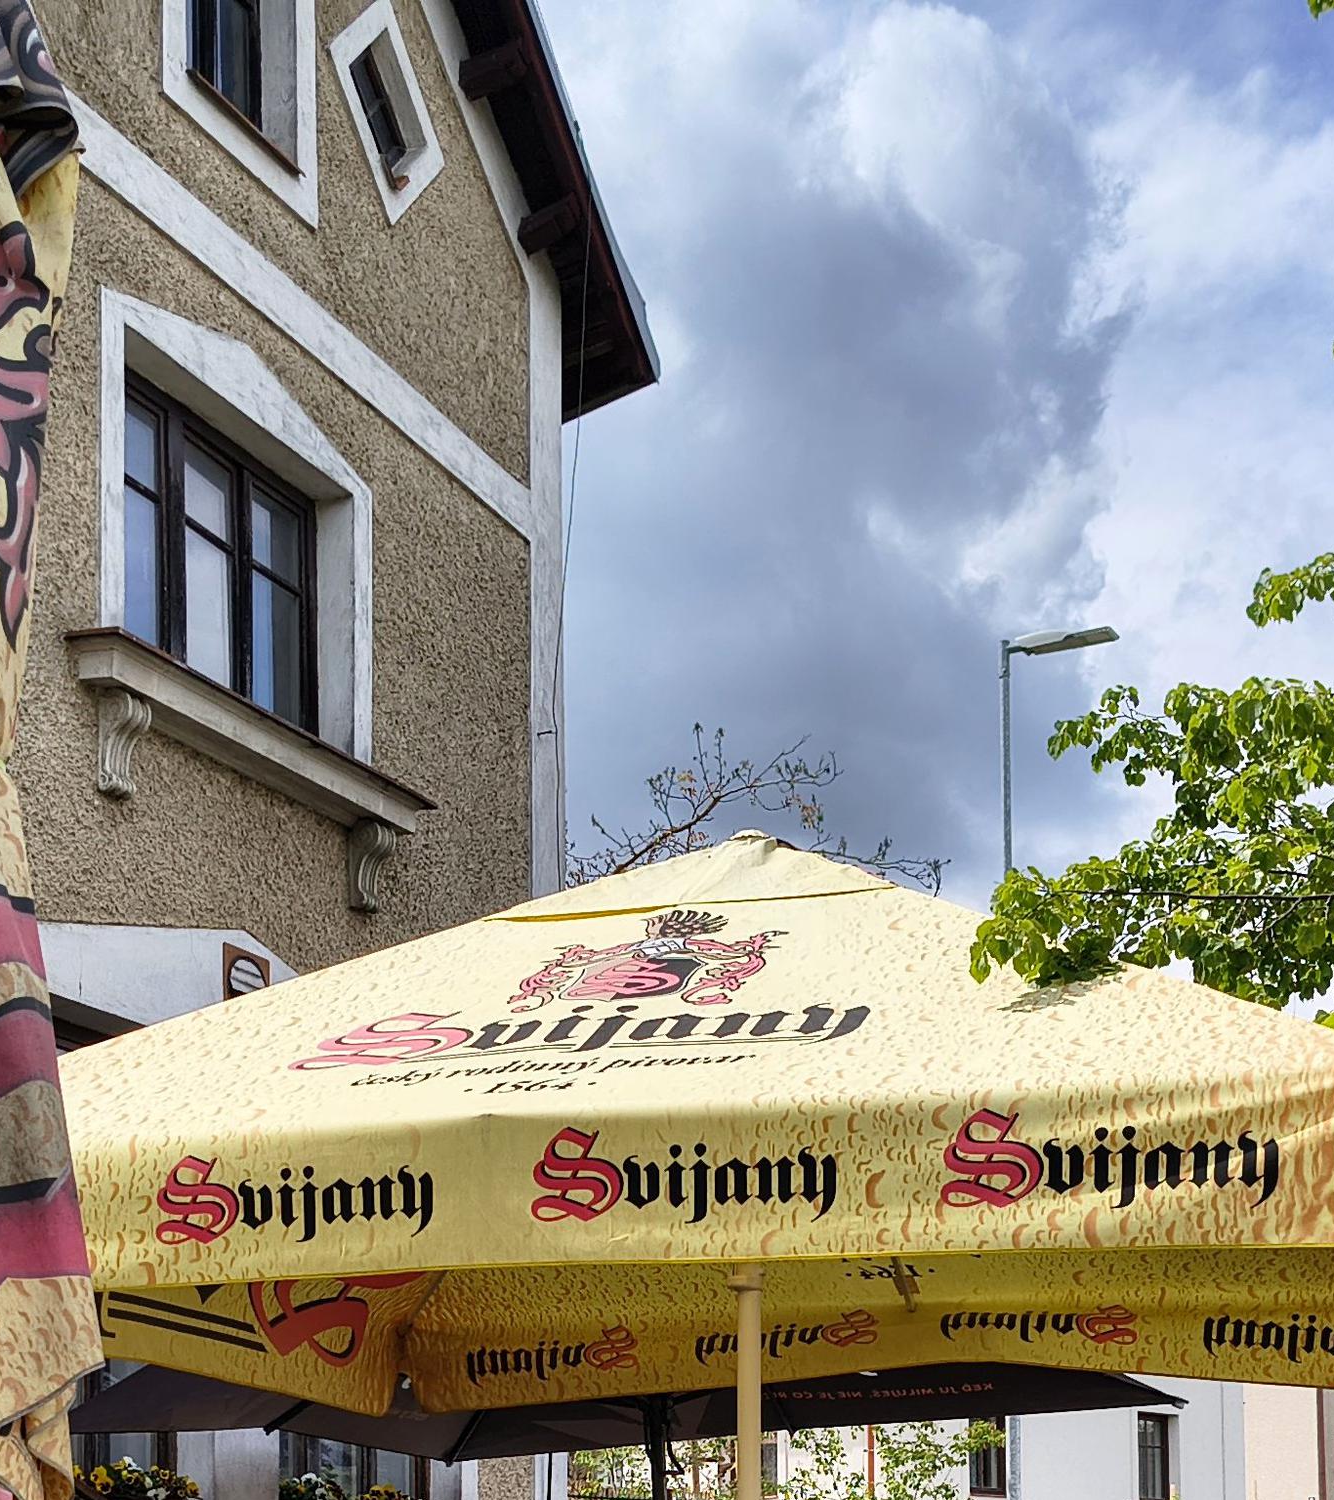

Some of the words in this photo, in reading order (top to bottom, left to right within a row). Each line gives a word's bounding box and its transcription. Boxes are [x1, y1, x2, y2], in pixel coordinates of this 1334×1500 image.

[288, 1004, 871, 1072] Svijany
[351, 1064, 445, 1088] český
[447, 1055, 601, 1080] rodinný
[600, 1050, 757, 1075] pivovar
[481, 1079, 579, 1095] 1564
[155, 1155, 434, 1245] Svijany
[531, 1126, 837, 1224] Svijany
[939, 1108, 1280, 1209] Svijany
